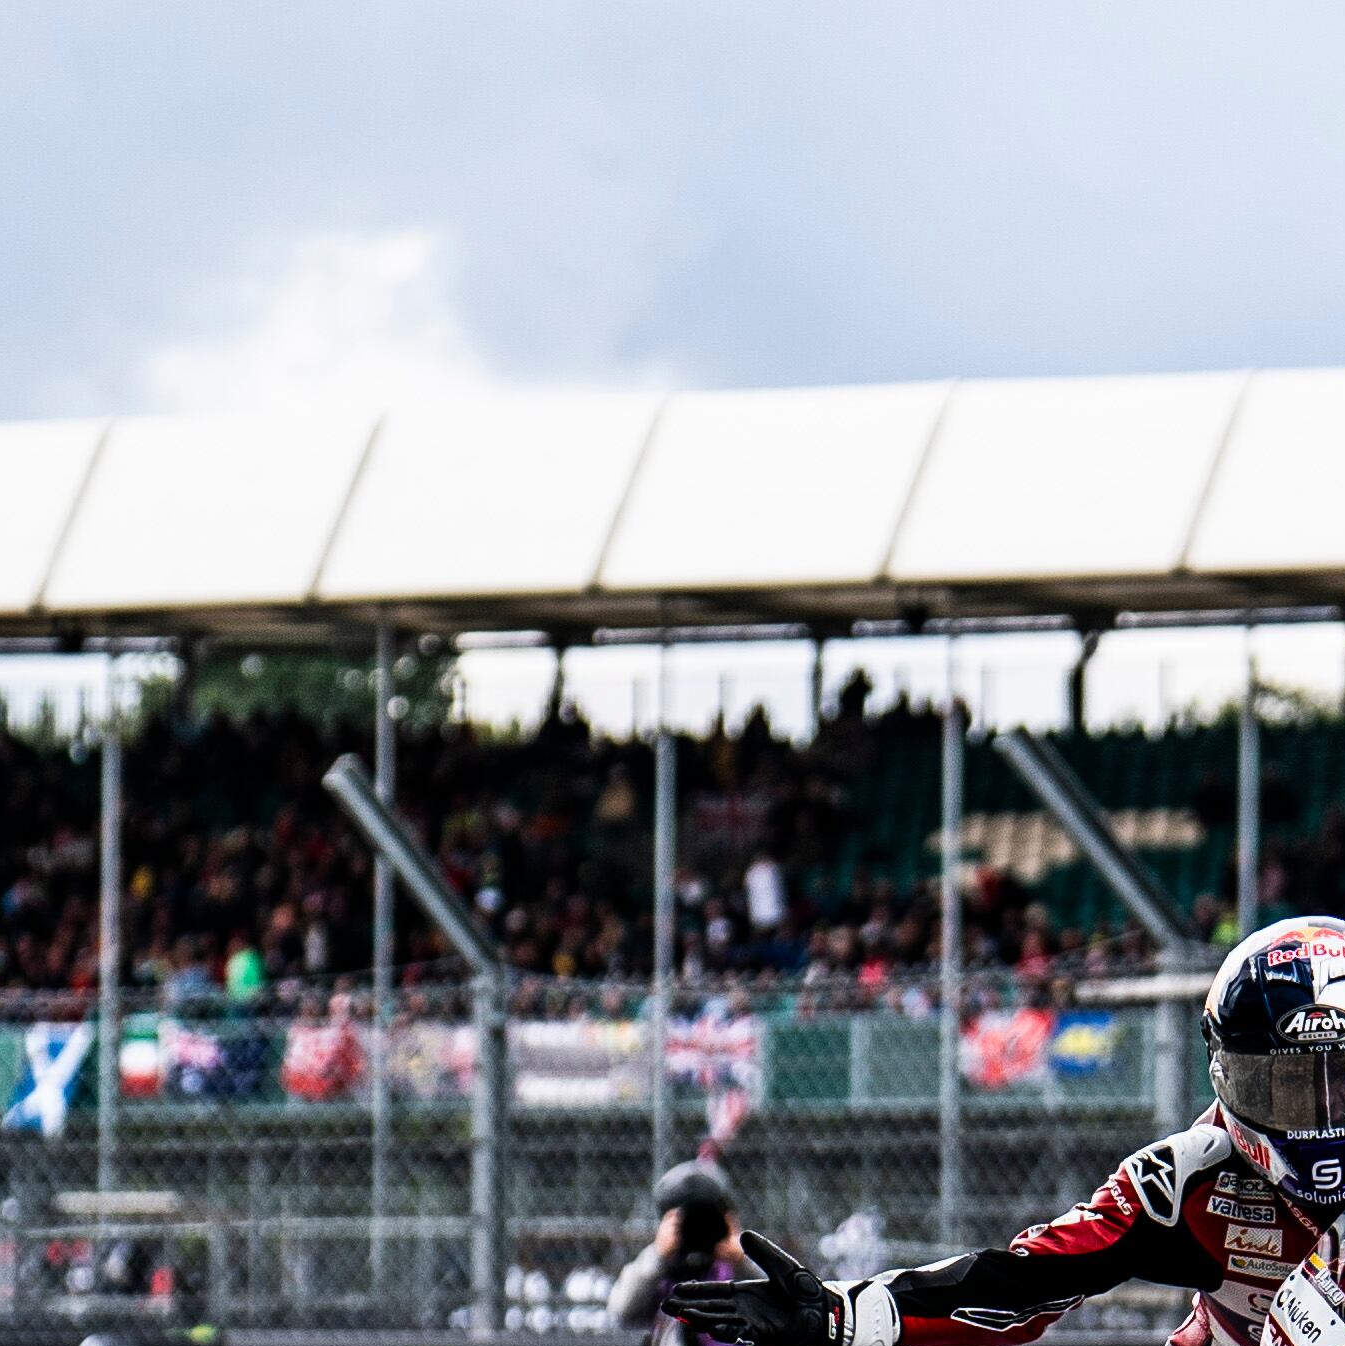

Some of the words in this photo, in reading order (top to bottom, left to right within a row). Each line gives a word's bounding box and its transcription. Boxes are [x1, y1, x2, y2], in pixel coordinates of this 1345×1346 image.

[1267, 943, 1310, 967] Red
[1270, 1047, 1301, 1055] GIVES
[1309, 1044, 1332, 1052] YOU
